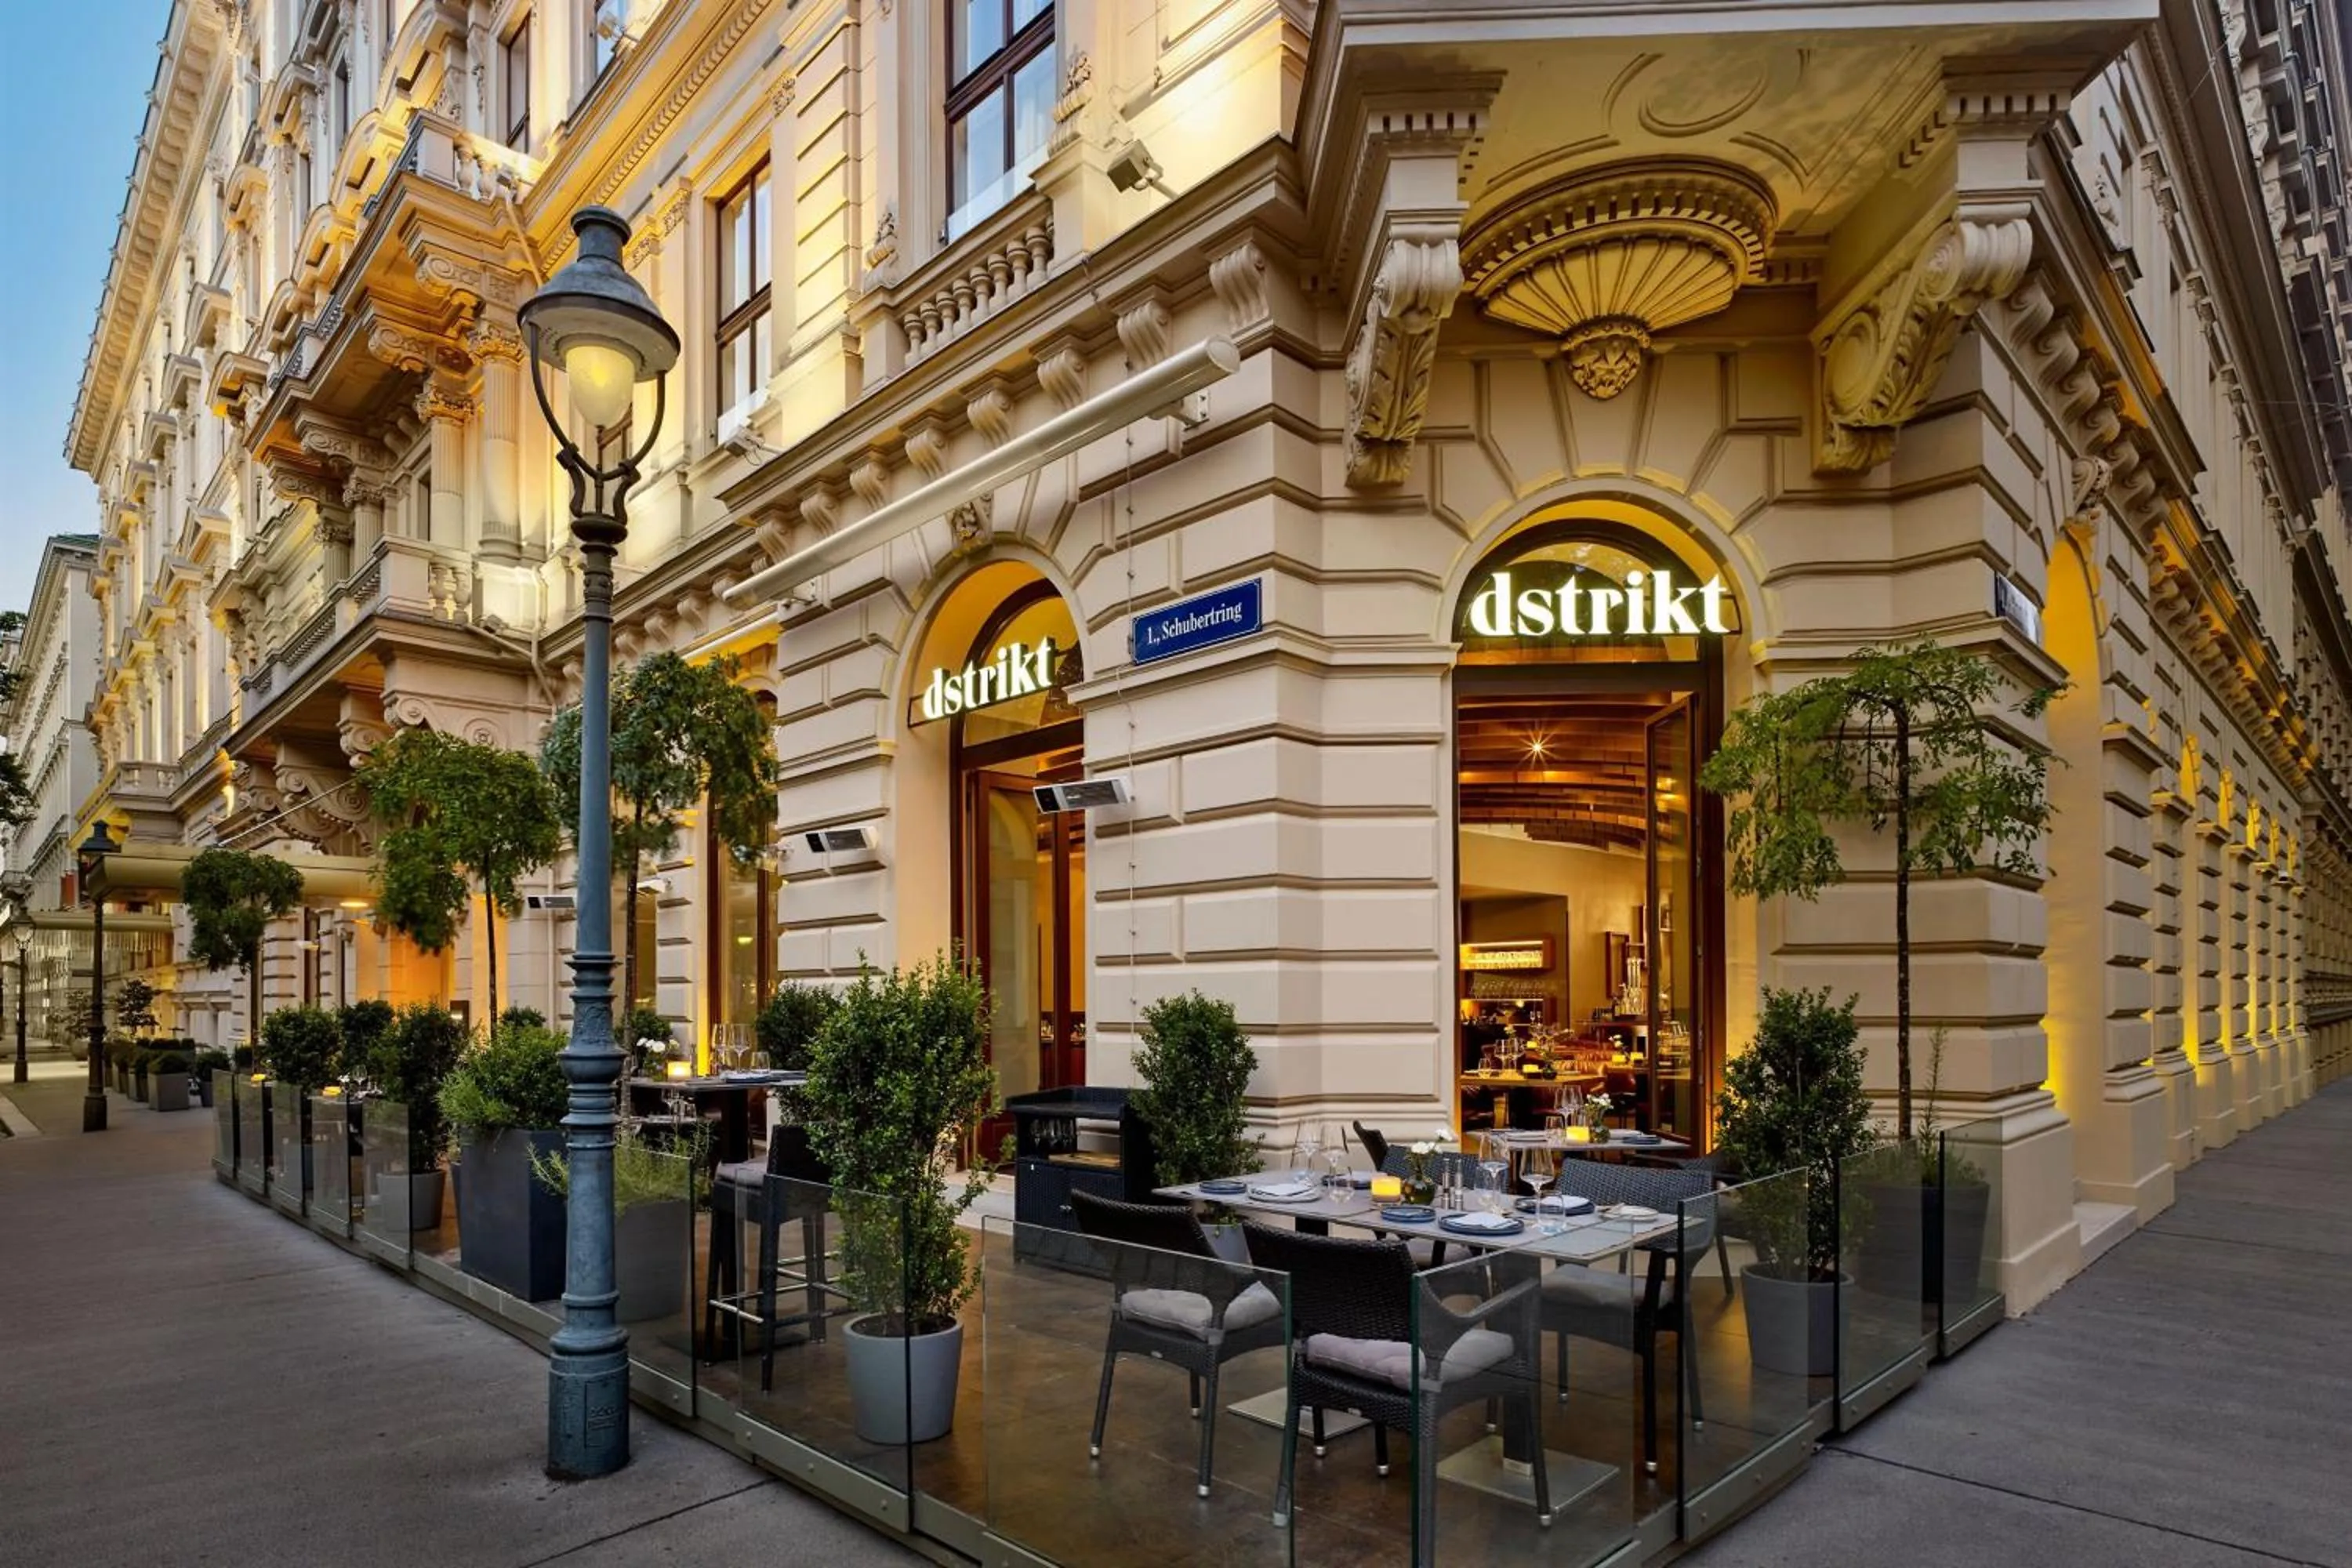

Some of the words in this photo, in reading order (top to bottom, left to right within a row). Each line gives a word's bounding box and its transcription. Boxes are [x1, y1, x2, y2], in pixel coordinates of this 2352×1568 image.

[1162, 602, 1242, 640] Schubertring
[1470, 570, 1730, 636] dstrikt
[923, 636, 1053, 719] dstrikt
